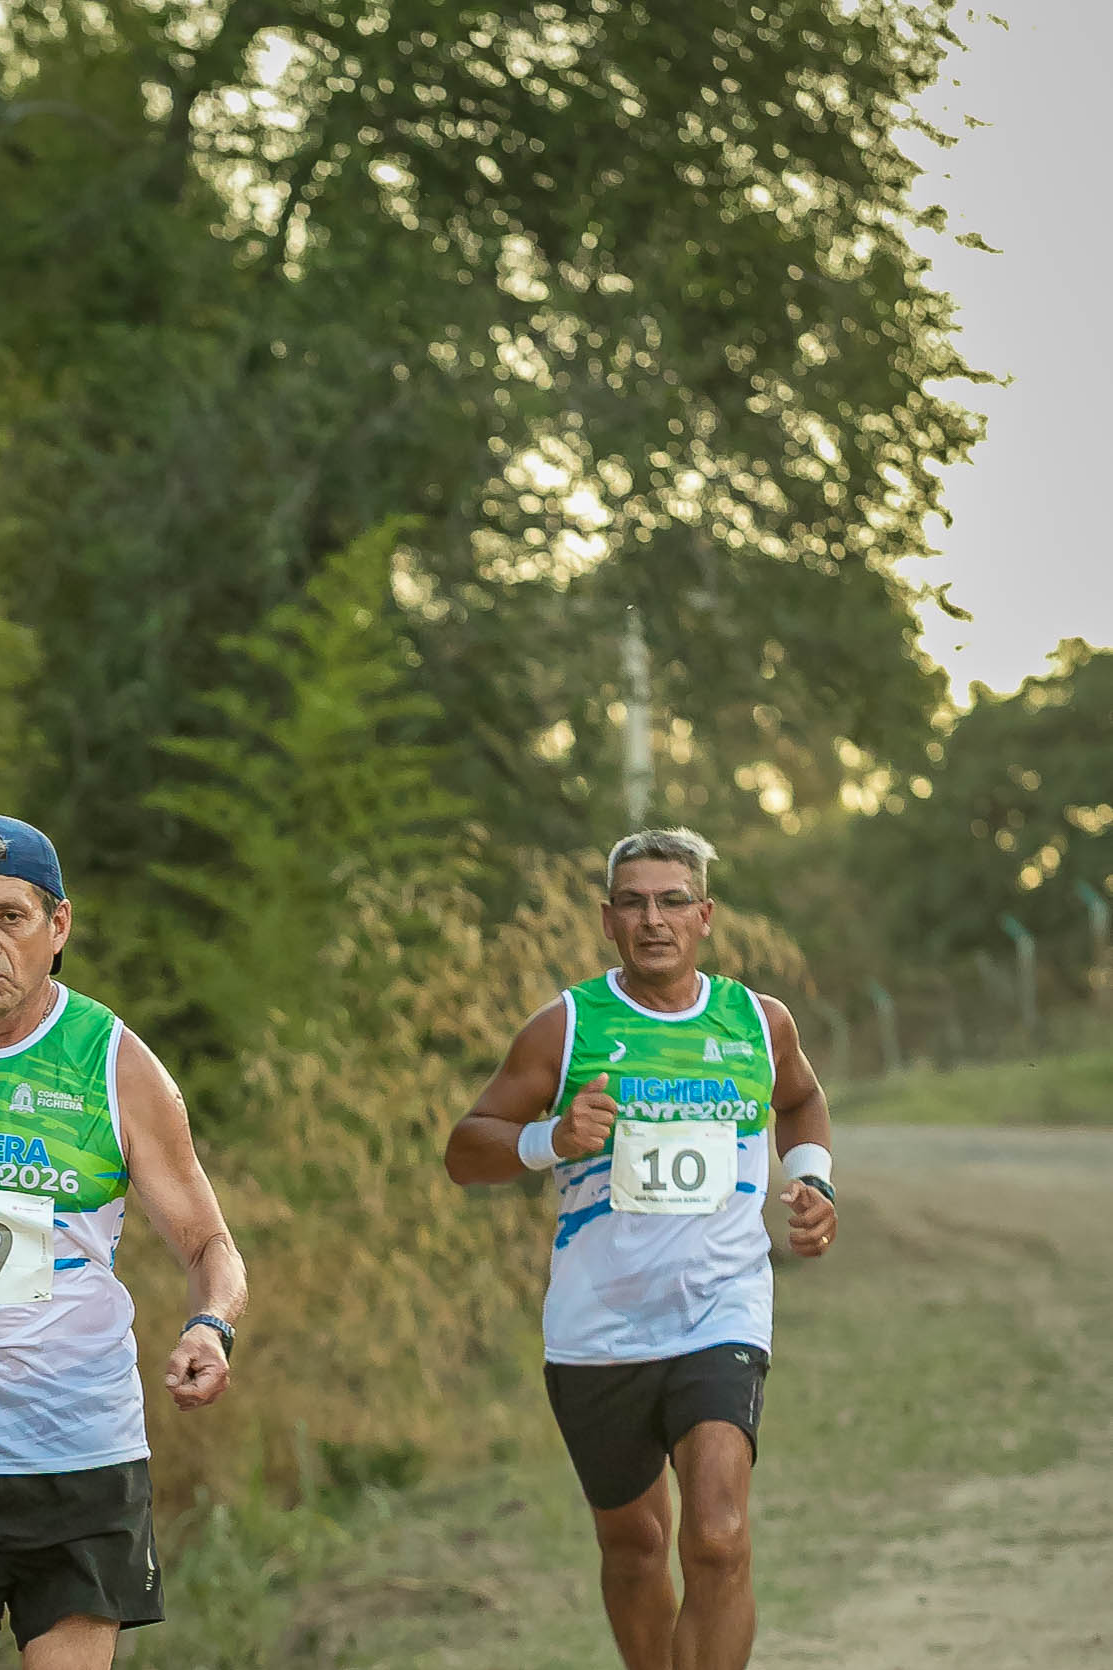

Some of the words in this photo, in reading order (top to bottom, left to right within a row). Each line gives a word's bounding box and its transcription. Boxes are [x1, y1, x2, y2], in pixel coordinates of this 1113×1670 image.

[37, 1090, 73, 1101] COMUNA
[619, 1076, 742, 1103] FIGHIERA
[36, 1097, 84, 1112] FIGHIERA
[641, 1147, 707, 1192] 10
